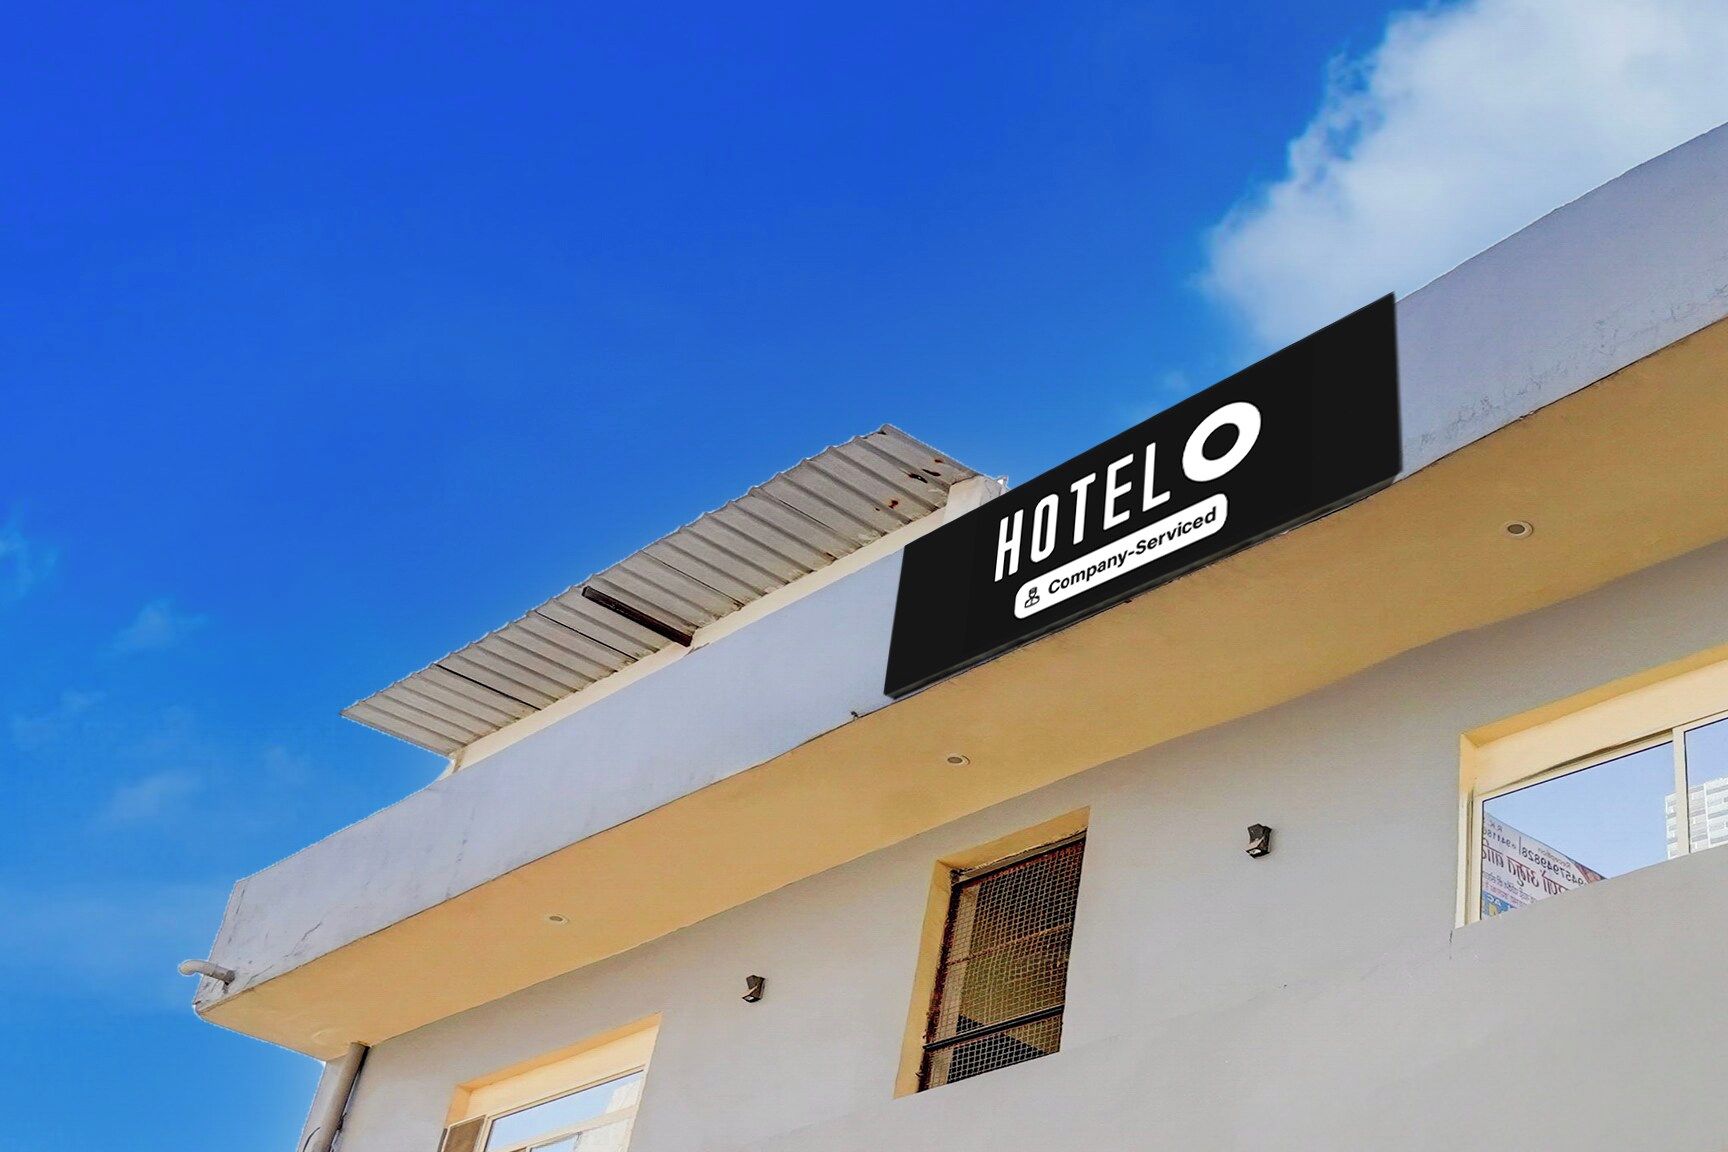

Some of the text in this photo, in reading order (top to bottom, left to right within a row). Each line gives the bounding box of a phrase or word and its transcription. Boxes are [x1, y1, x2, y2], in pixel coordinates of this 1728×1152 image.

[994, 401, 1262, 583] HOTEL O
[1048, 505, 1217, 595] Company-Serviced
